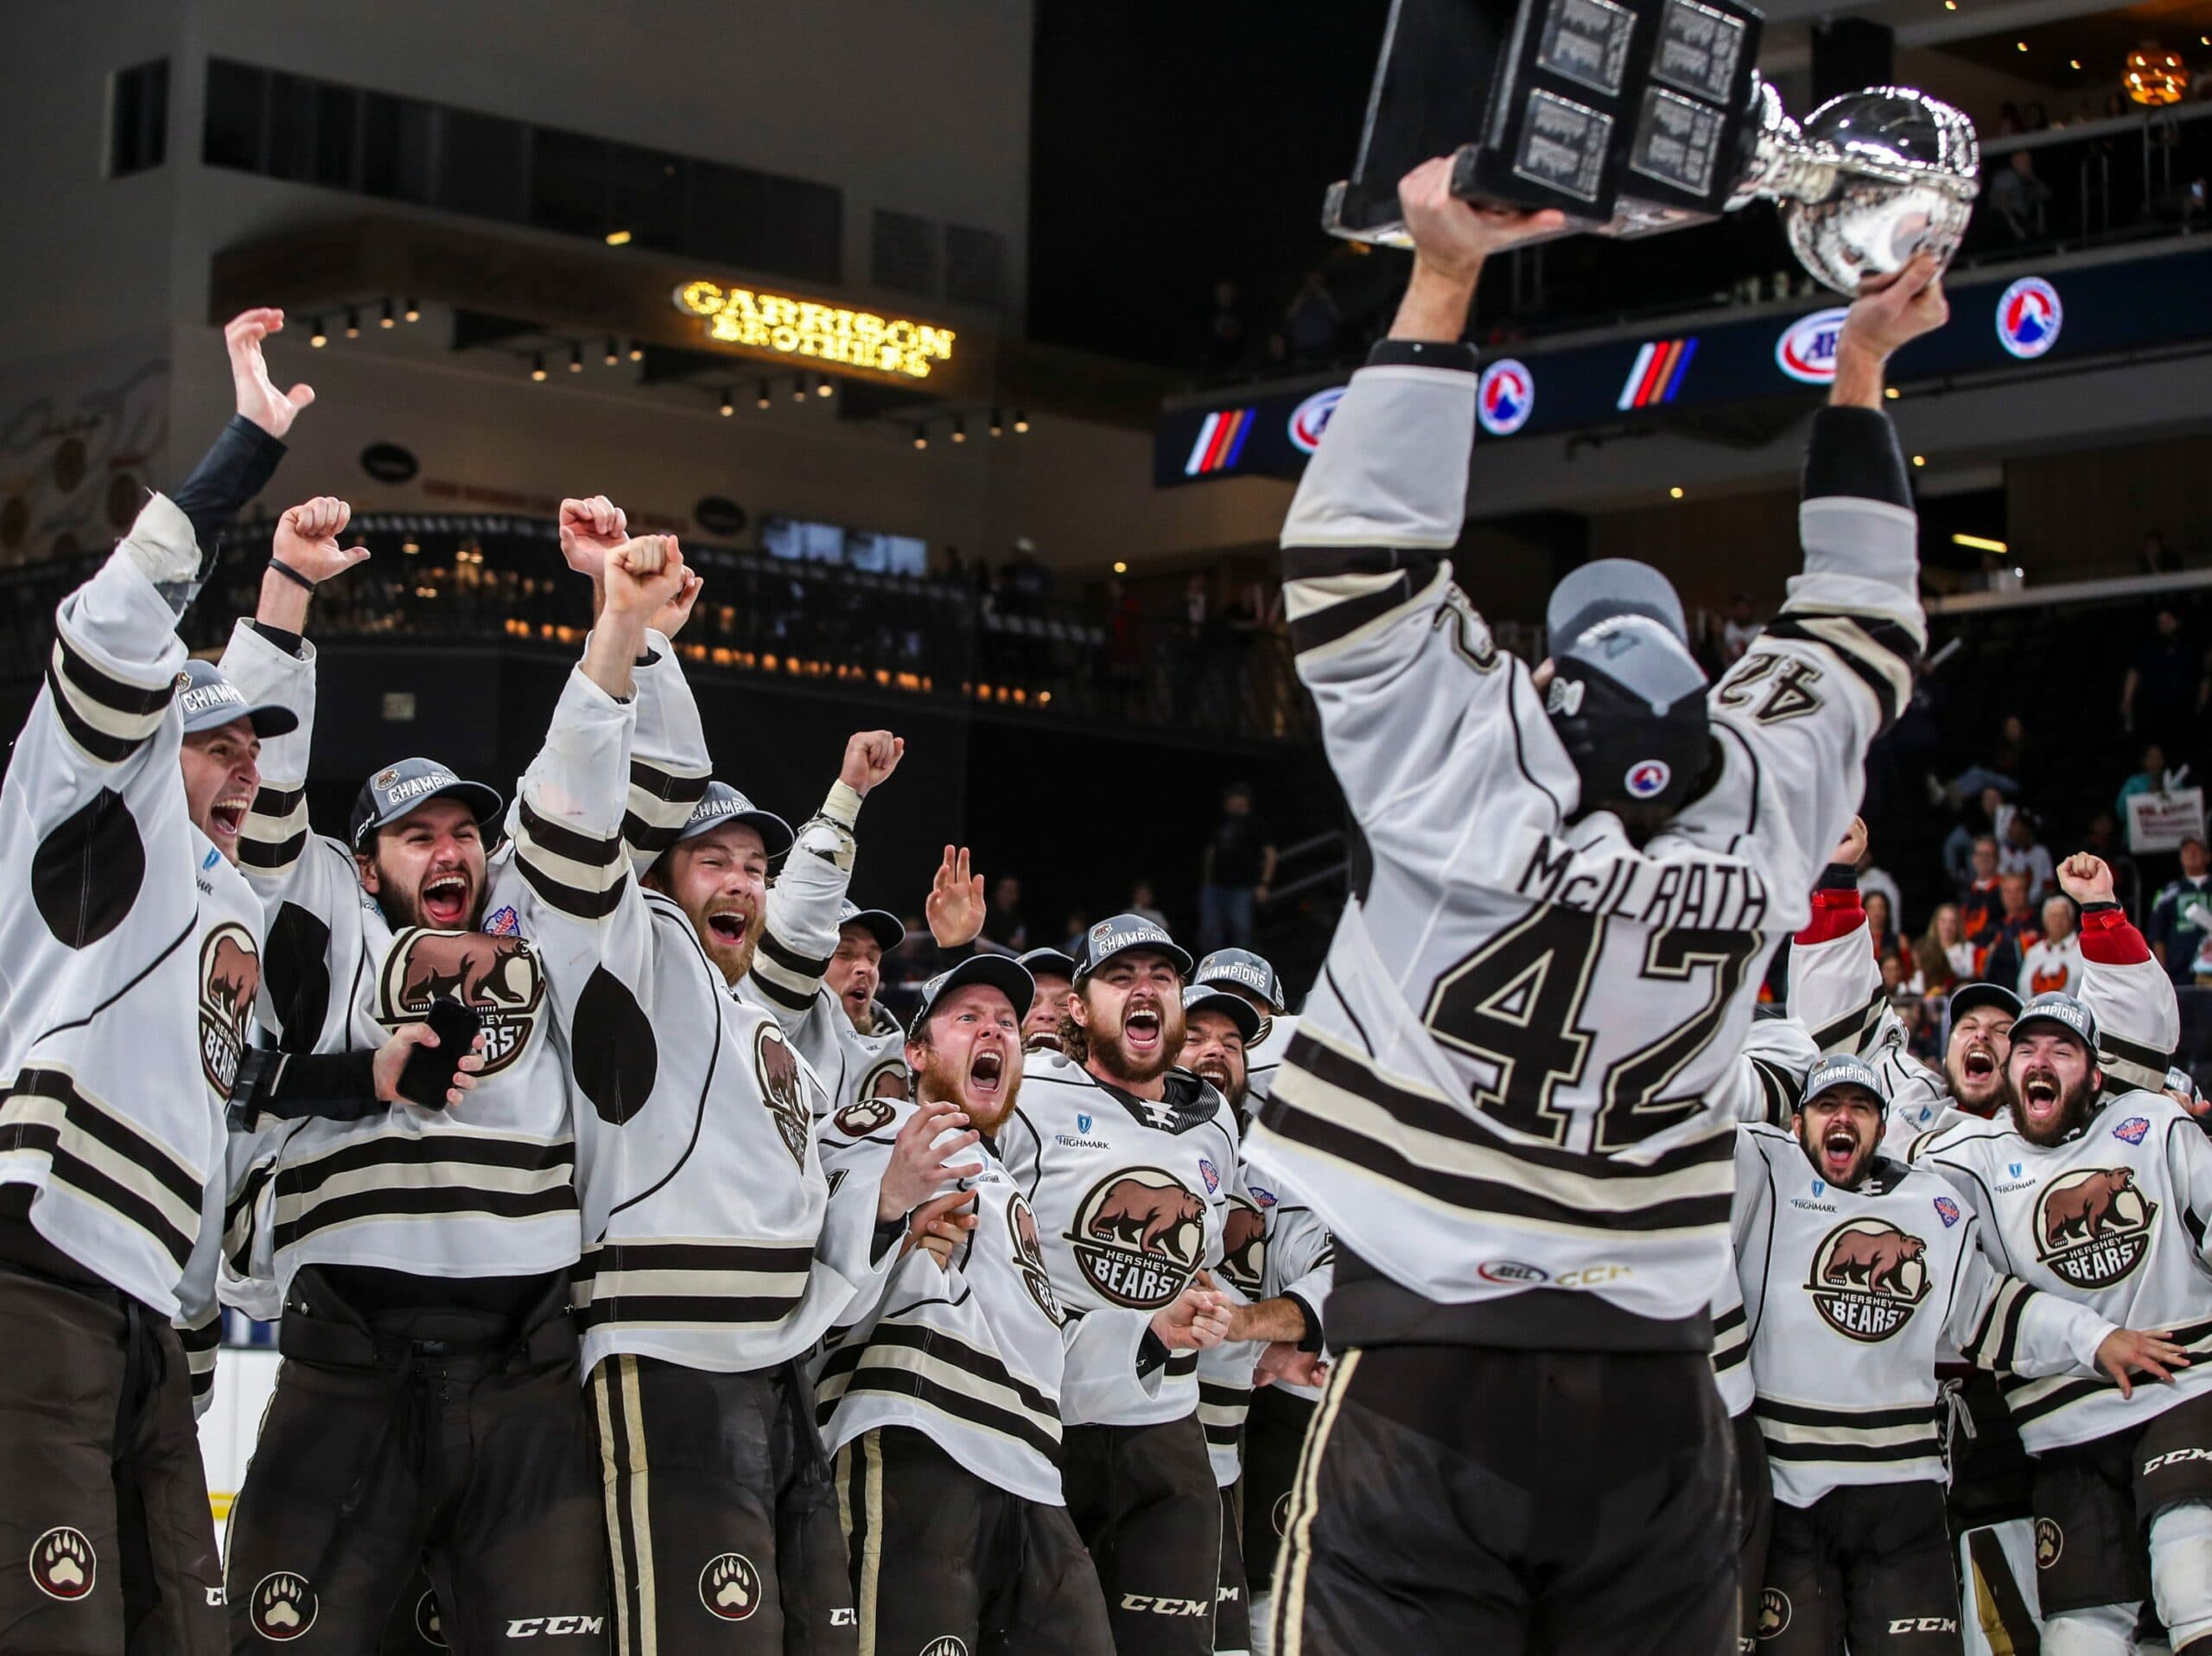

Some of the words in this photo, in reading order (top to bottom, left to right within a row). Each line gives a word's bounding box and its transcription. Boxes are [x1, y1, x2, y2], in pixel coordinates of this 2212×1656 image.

[681, 281, 956, 360] GARRISON
[1718, 653, 1825, 726] 42
[1421, 899, 1764, 1156] 42
[1814, 1066, 1878, 1089] CHAMPIONS
[1058, 1135, 1110, 1150] HIGHMARK
[1999, 1177, 2037, 1194] HIGHMARK
[1791, 1199, 1838, 1213] HIGHMARK
[2068, 1236, 2123, 1259] HERSHEY
[1105, 1249, 1170, 1274] HERSHEY
[2065, 1242, 2134, 1280] BEARS
[1093, 1256, 1175, 1299] BEARS
[1840, 1292, 1896, 1309] HERSHEY
[1832, 1300, 1900, 1334] BEARS
[1121, 1593, 1209, 1617] CCM
[505, 1615, 604, 1639] CCM
[1888, 1617, 1957, 1634] CCM
